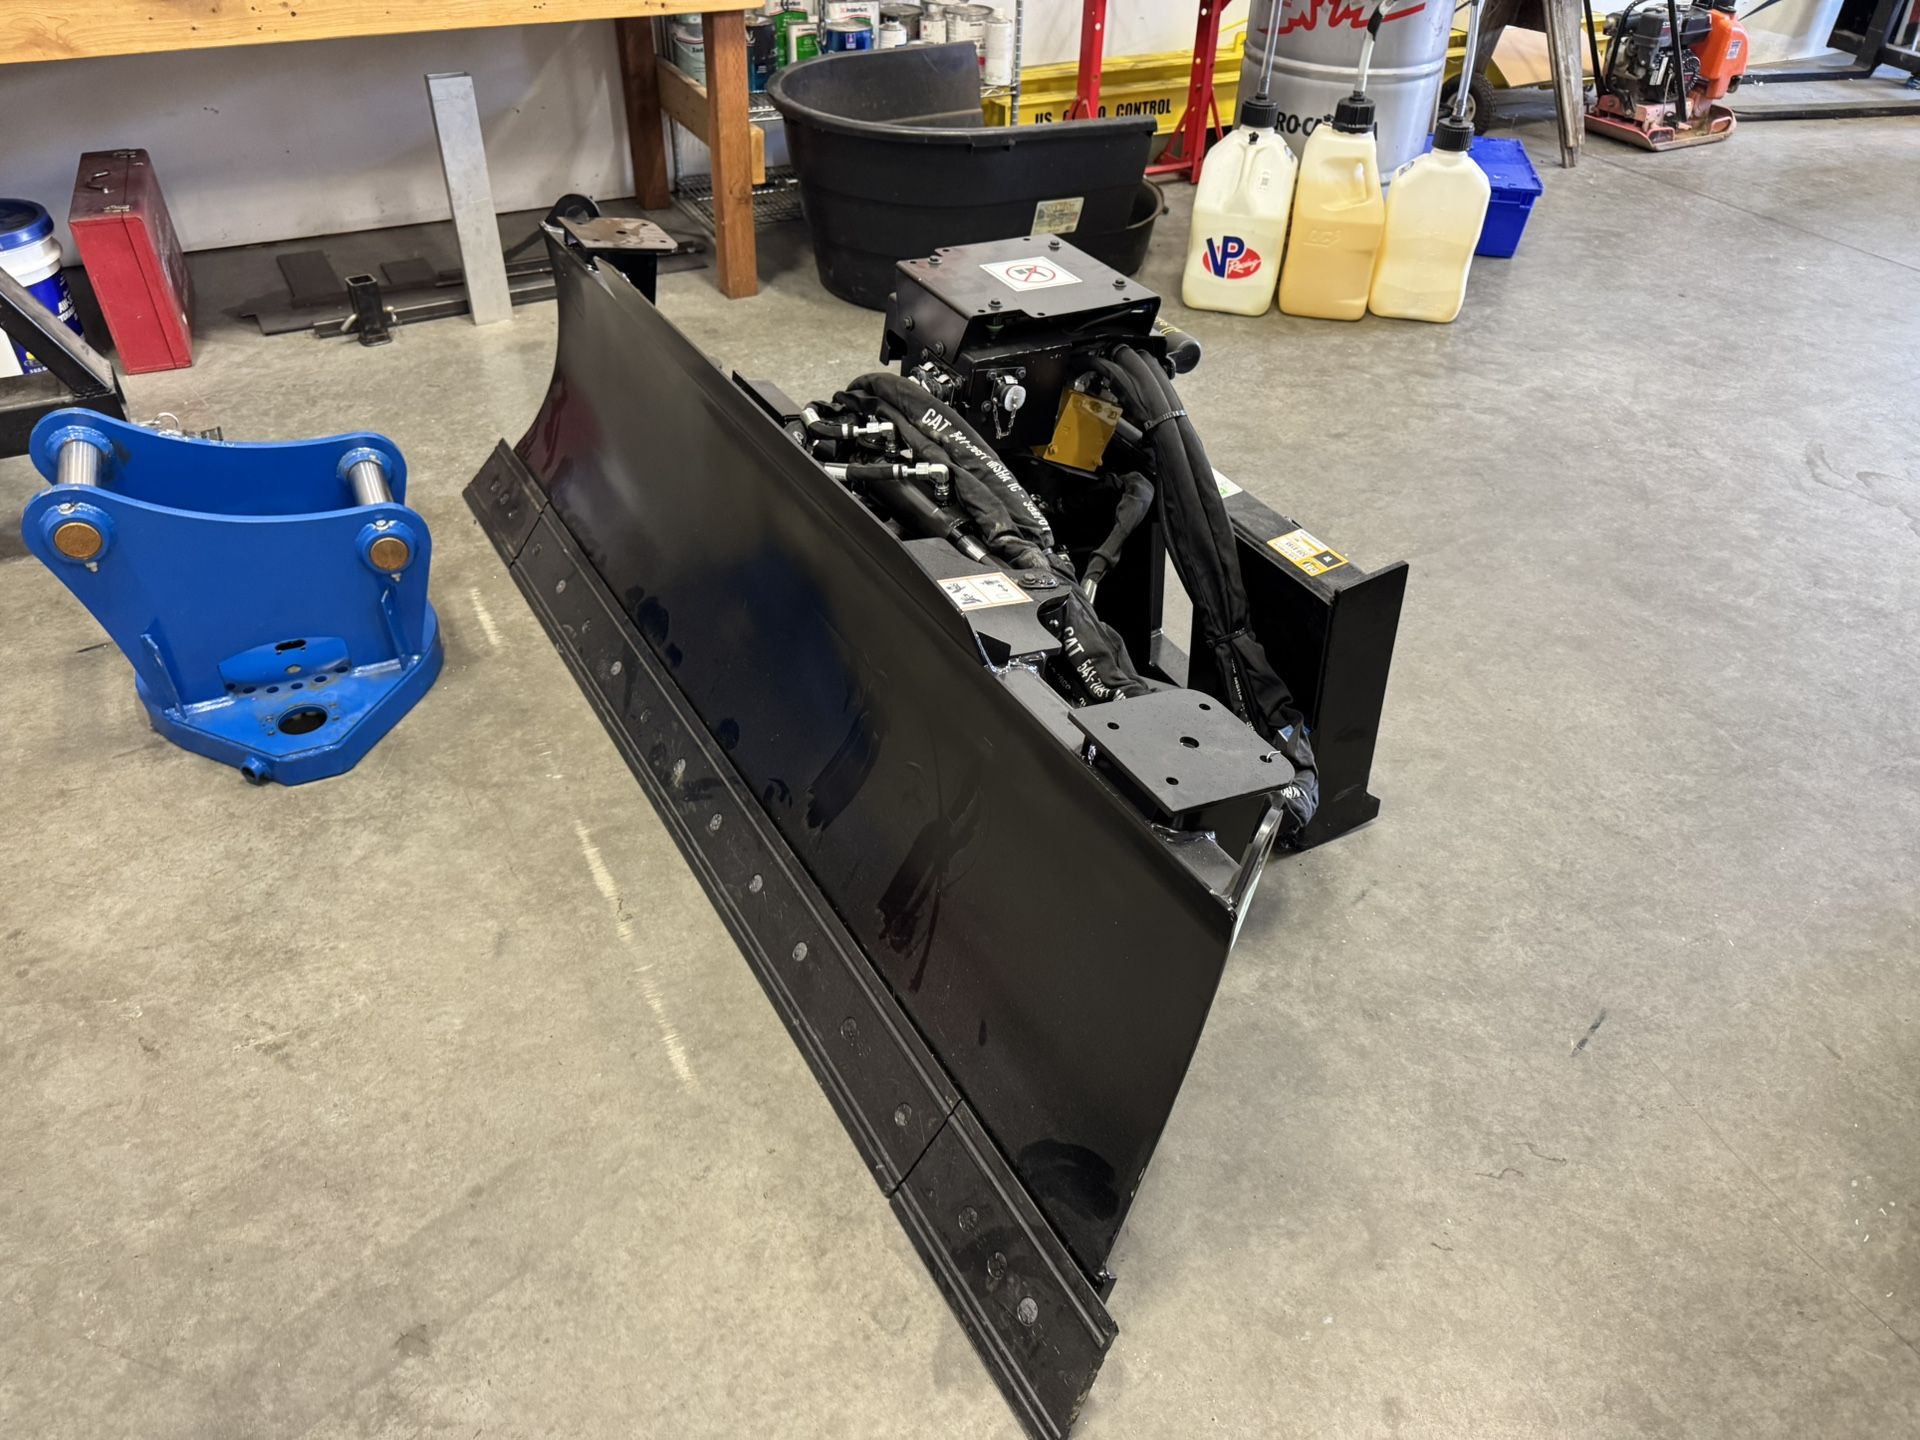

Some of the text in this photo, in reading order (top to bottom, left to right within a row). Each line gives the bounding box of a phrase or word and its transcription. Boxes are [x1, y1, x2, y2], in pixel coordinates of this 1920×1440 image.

[1116, 99, 1171, 117] CONTROL
[1206, 235, 1245, 279] VP
[1228, 258, 1262, 275] Racing
[921, 408, 952, 432] CAT
[986, 460, 1013, 482] MSHA
[1064, 626, 1085, 657] CAT
